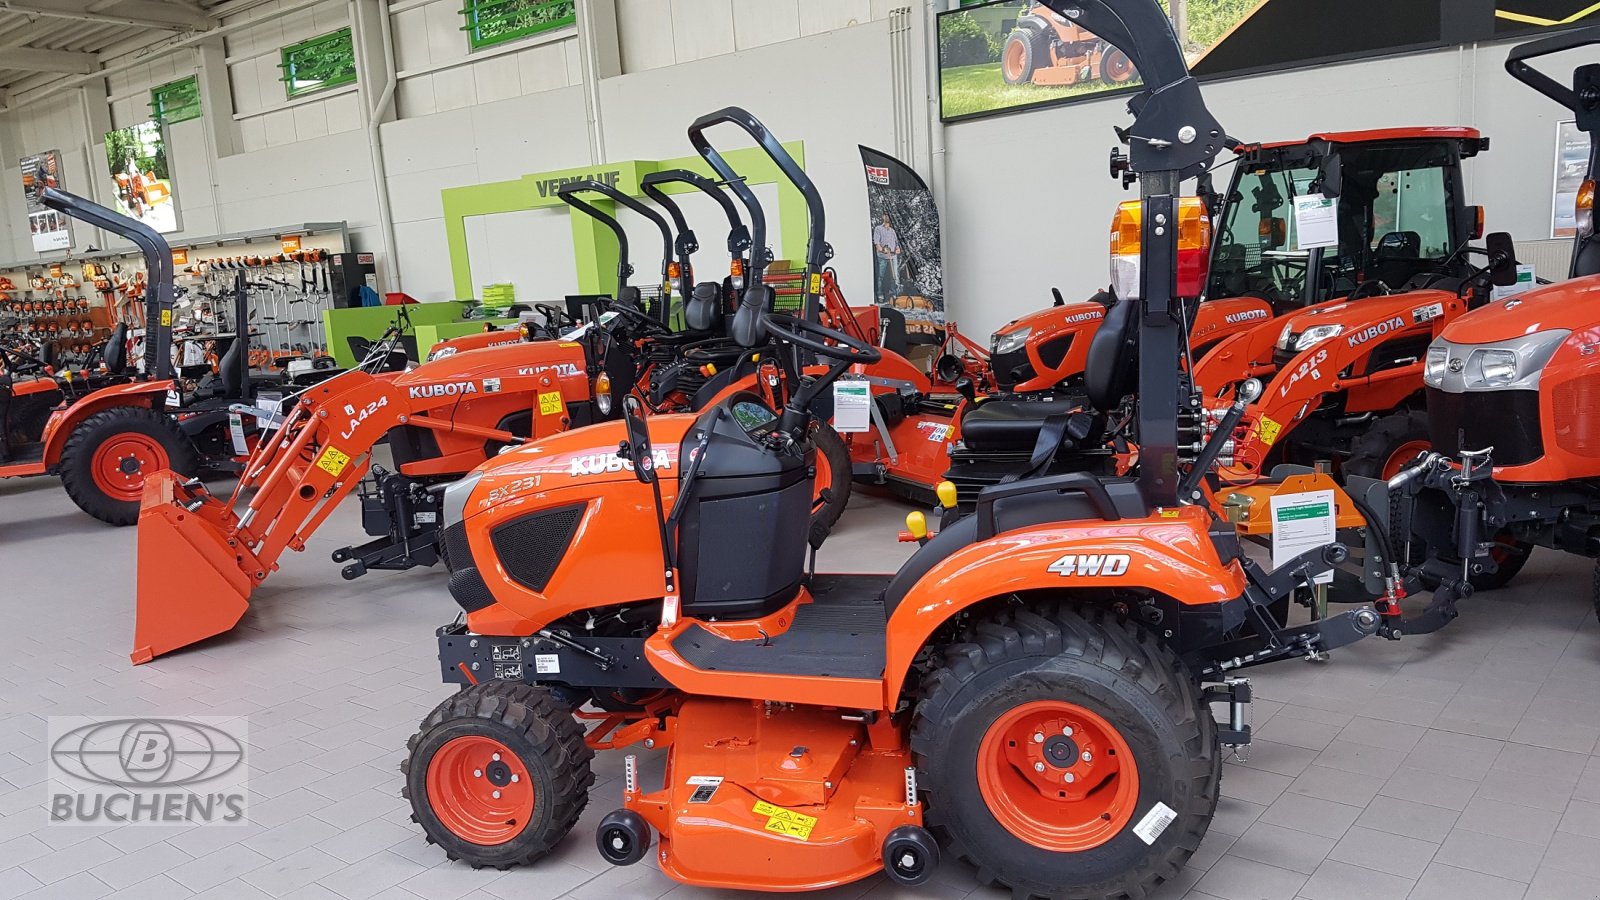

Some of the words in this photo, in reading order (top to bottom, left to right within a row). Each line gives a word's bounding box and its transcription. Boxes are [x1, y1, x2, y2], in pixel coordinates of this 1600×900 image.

[1064, 310, 1103, 324] KUBOTA
[1225, 308, 1268, 324] KUBOTA
[487, 339, 520, 348] KUBOT
[1347, 316, 1405, 348] KUBOTA
[1280, 349, 1328, 398] LA213
[409, 381, 477, 399] KUBOTA
[341, 395, 388, 440] LA424
[570, 449, 672, 477] KUBA
[1046, 553, 1132, 577] 4WD
